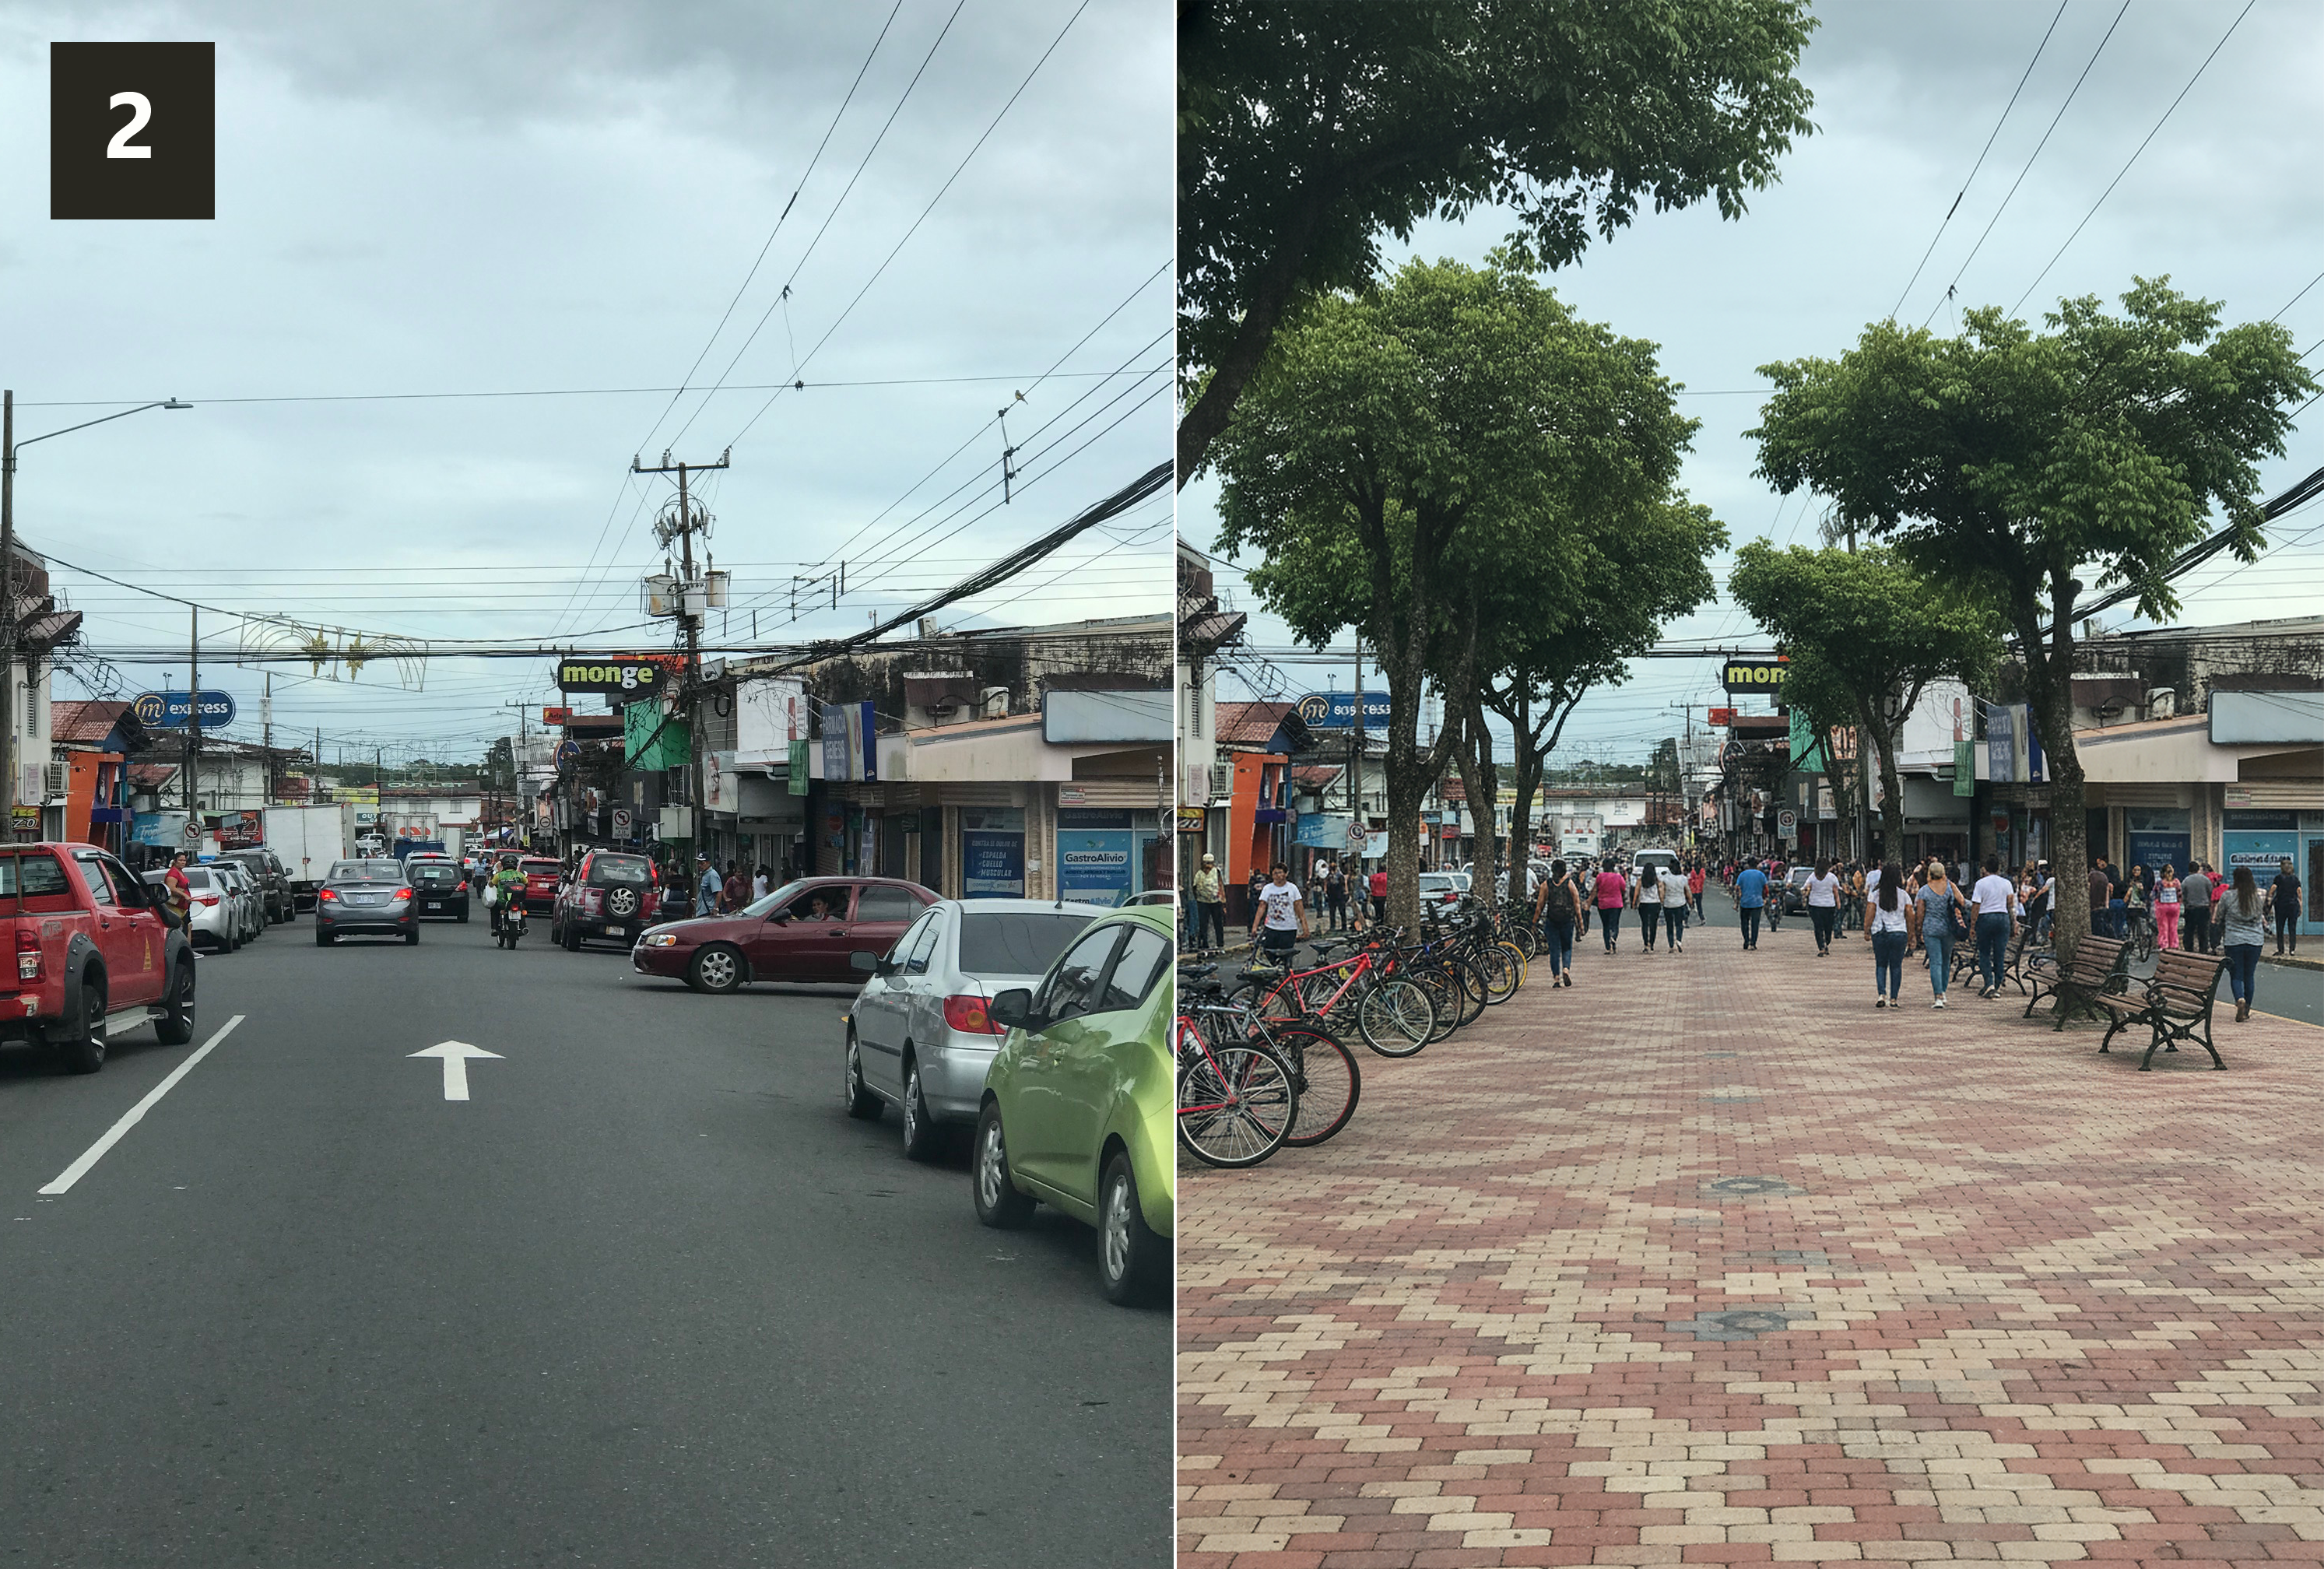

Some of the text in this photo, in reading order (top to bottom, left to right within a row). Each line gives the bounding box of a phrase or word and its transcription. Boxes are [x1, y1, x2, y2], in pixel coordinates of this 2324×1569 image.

[563, 666, 653, 689] monge
[169, 703, 228, 716] exress
[822, 714, 847, 735] FARMACIA
[12, 818, 37, 829] ZO
[1065, 853, 1124, 862] GastroAlivio
